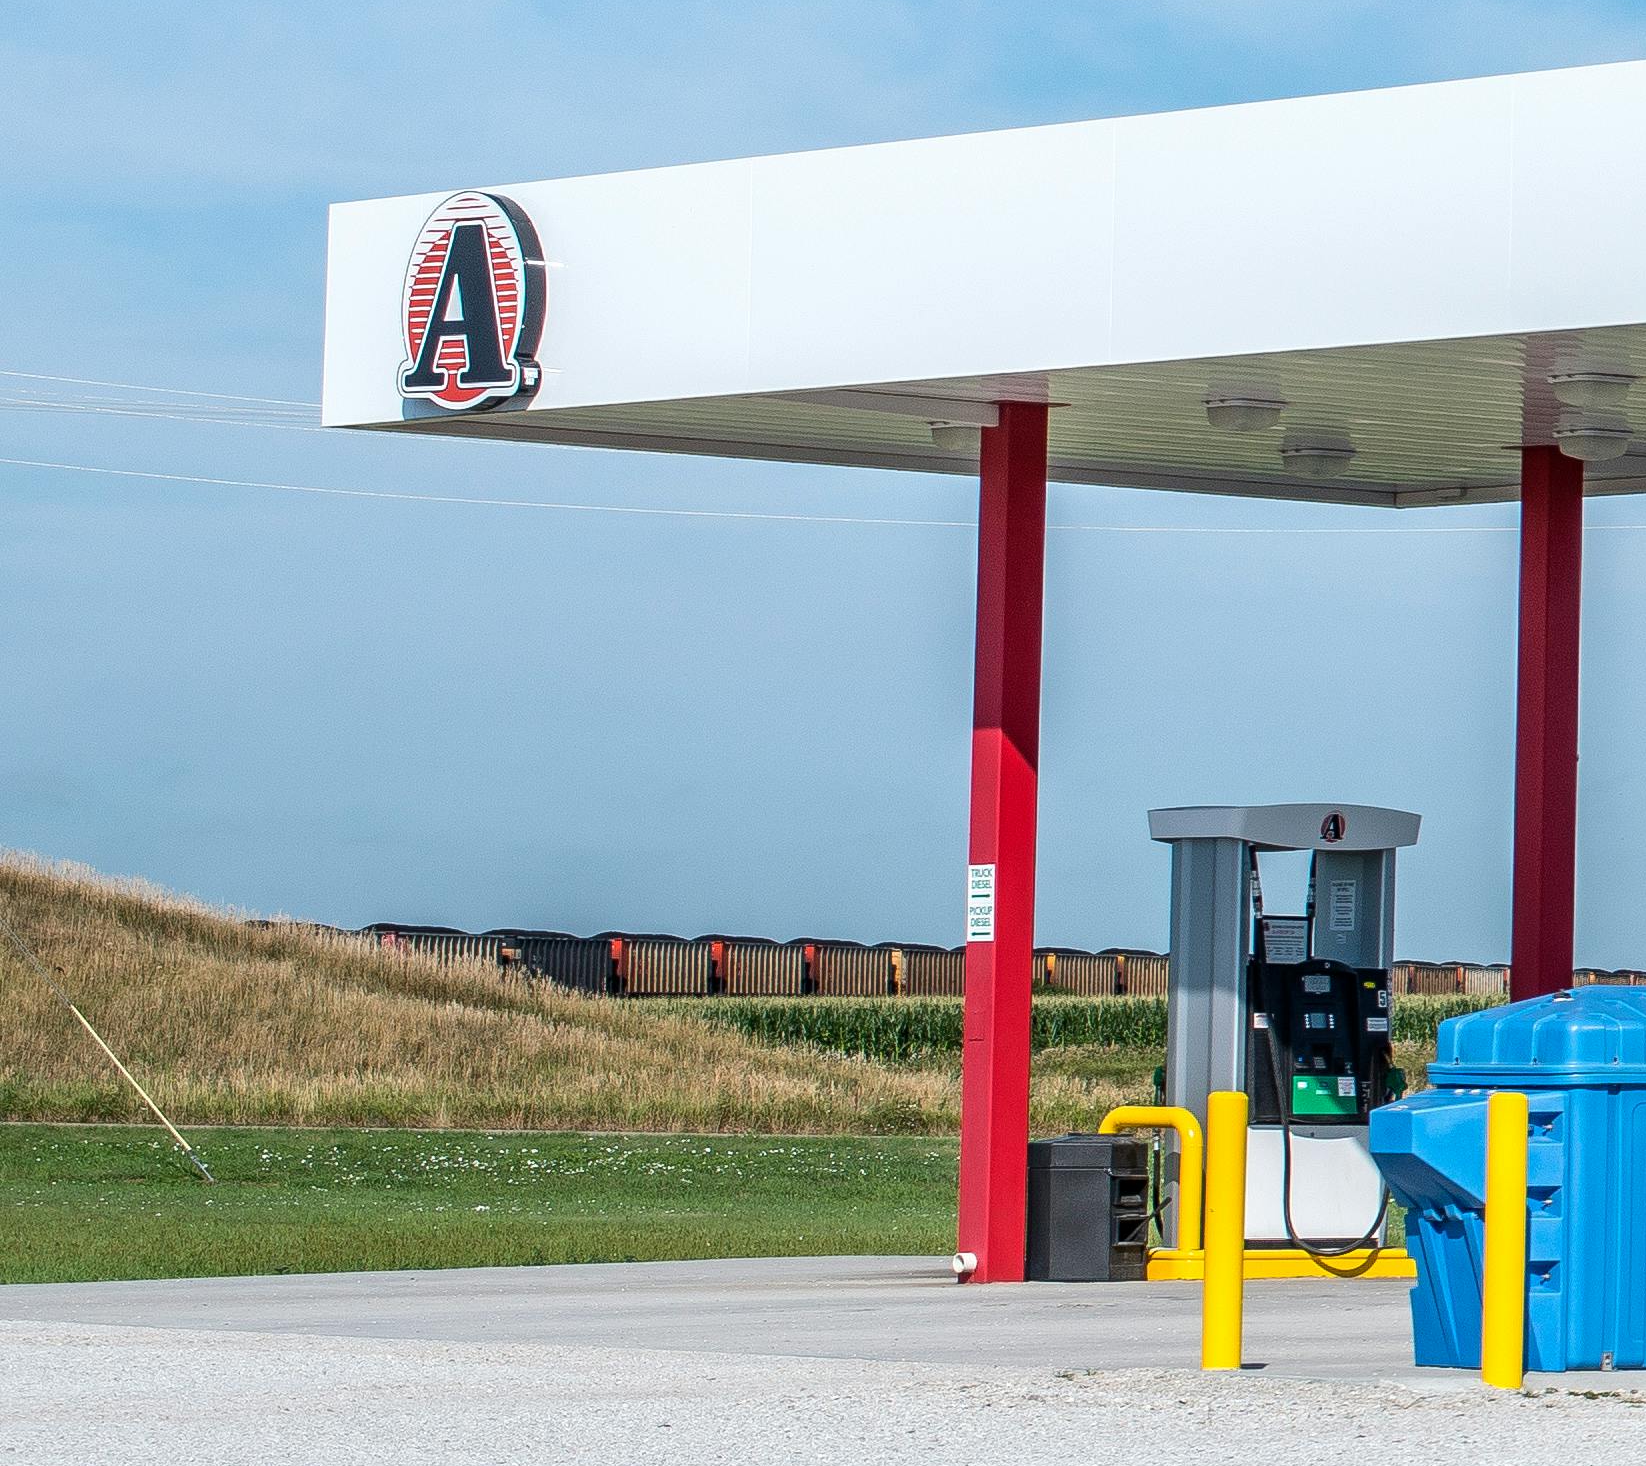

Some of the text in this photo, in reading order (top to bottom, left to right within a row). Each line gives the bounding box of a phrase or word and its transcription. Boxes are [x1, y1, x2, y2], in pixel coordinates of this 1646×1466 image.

[403, 223, 515, 387] A
[971, 868, 993, 878] TRUCK
[971, 879, 993, 889] DIESEL
[969, 905, 993, 916] PICKUP
[970, 917, 991, 927] DIESEL
[1378, 991, 1387, 1006] 5
